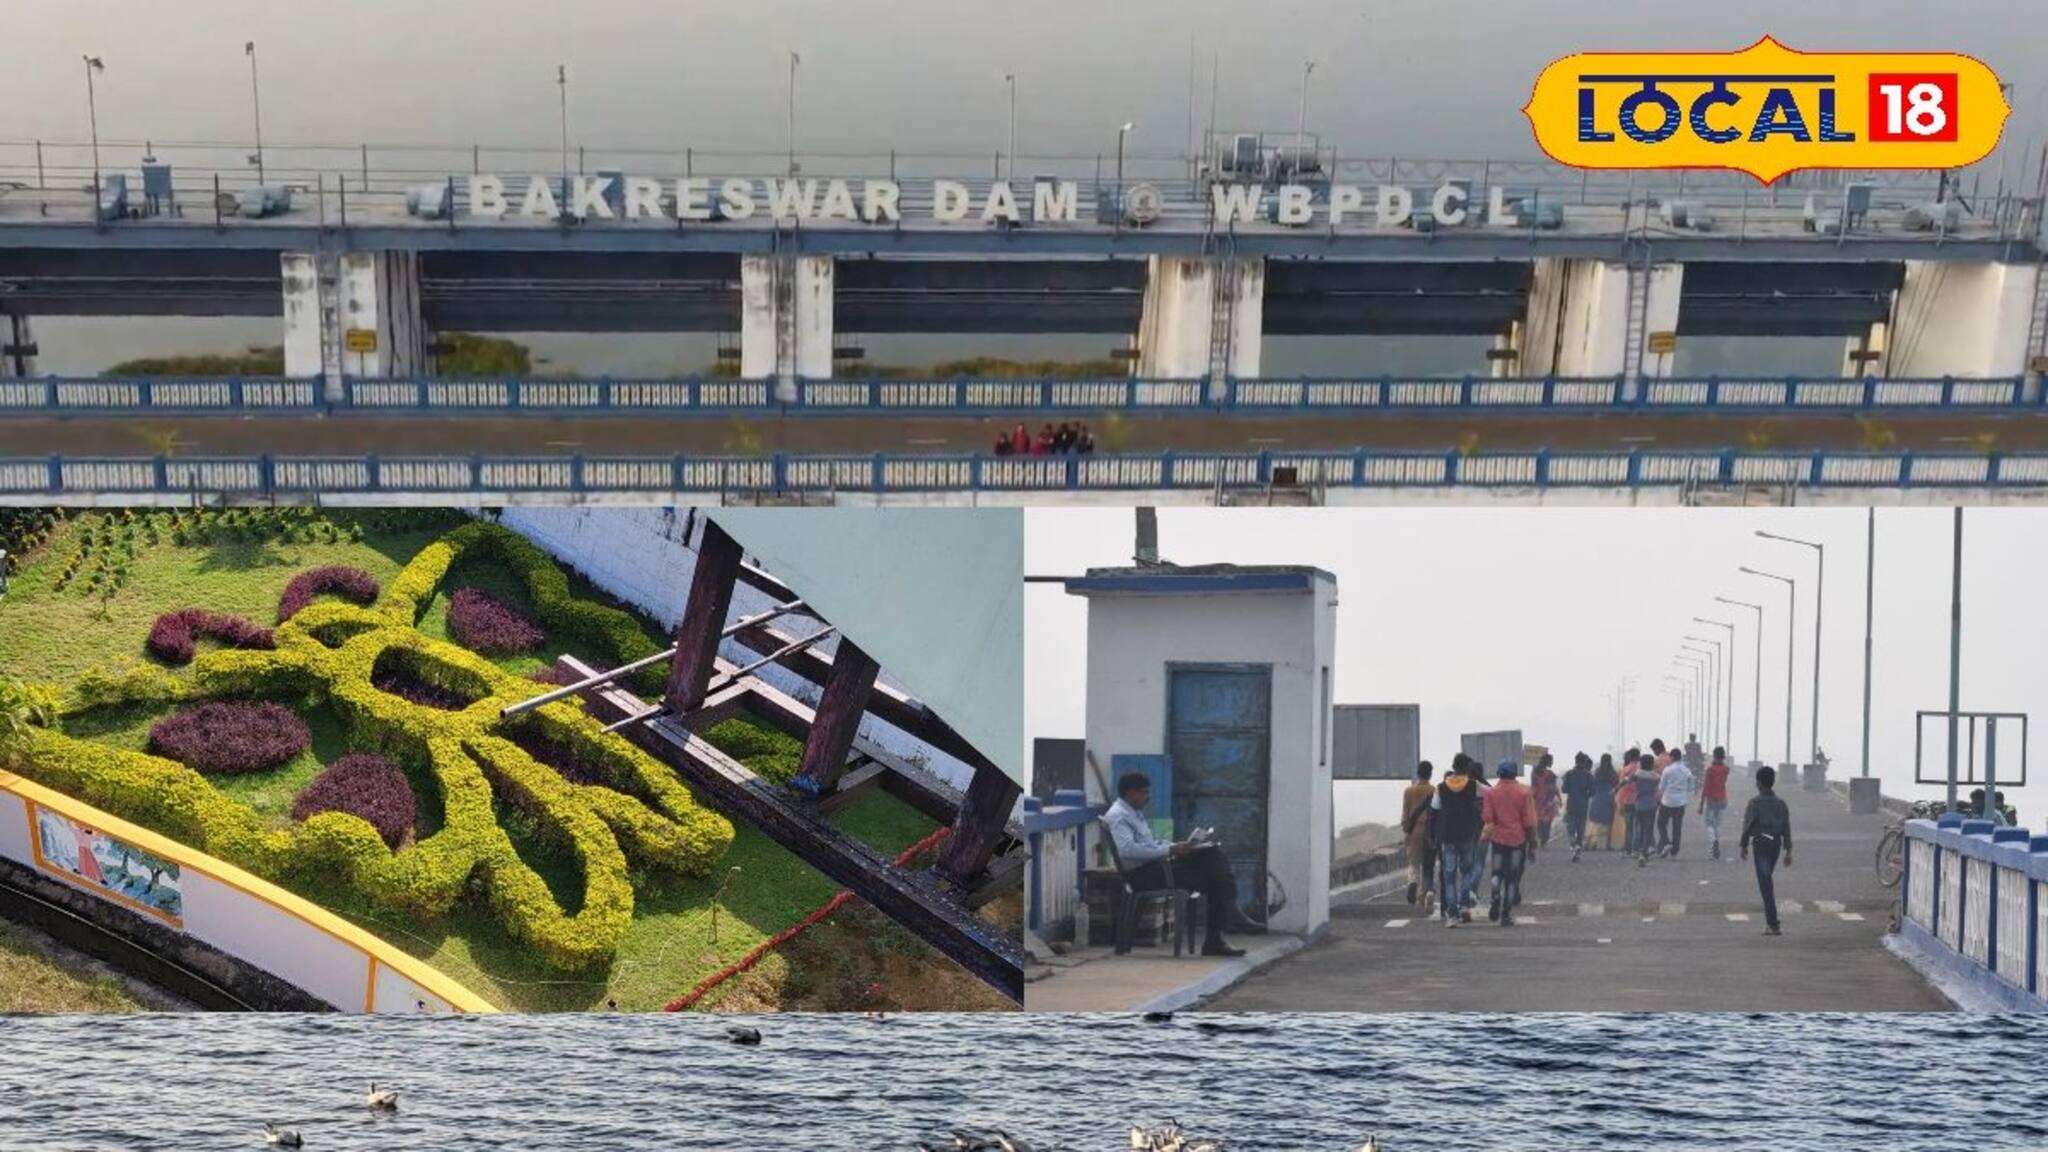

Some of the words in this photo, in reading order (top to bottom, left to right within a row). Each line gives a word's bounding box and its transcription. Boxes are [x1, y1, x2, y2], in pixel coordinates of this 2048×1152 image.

[469, 174, 900, 221] BAKRESWAR
[932, 178, 1078, 222] DAM
[1211, 181, 1518, 226] WBPDCL
